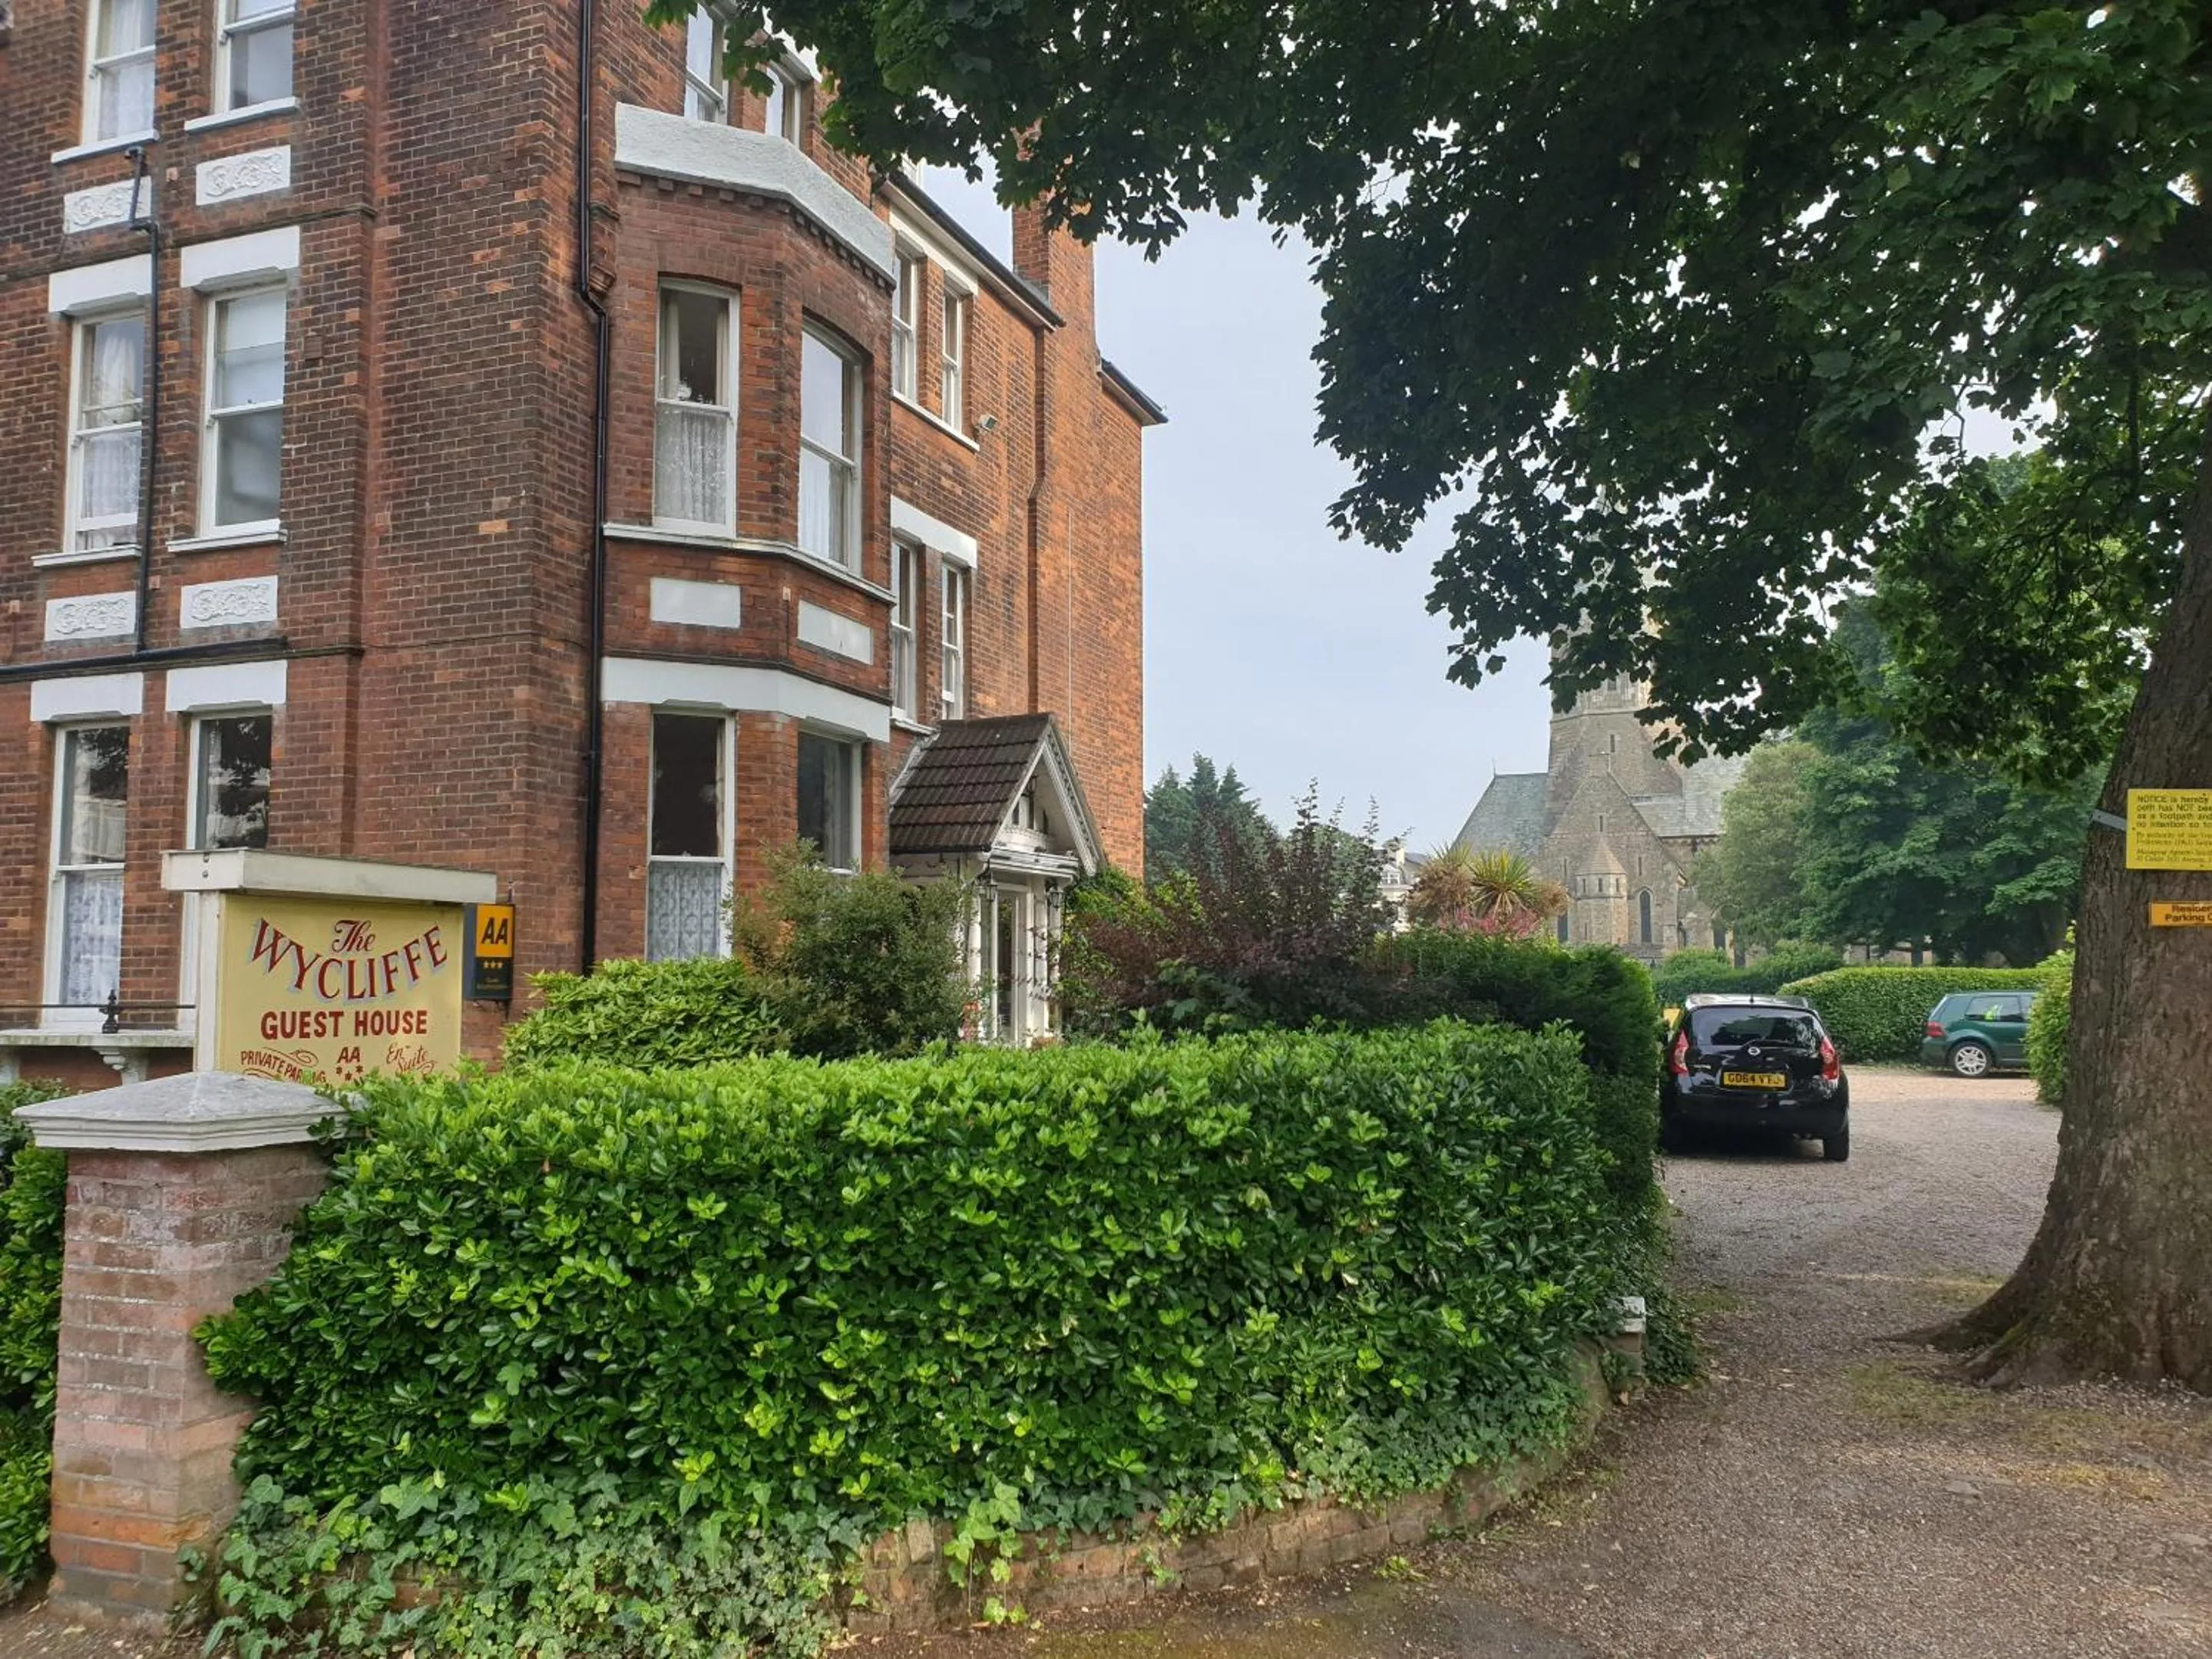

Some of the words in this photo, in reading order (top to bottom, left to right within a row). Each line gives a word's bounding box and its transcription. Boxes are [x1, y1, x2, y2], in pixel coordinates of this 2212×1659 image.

[2137, 795, 2167, 803] NOTICE
[2181, 795, 2209, 805] hereby
[2159, 812, 2194, 821] footpath
[2165, 913, 2205, 922] Parking
[332, 920, 376, 953] The
[481, 917, 508, 945] AA
[252, 918, 448, 999] WYCLIFFE
[261, 1010, 344, 1039] GUEST
[354, 1010, 428, 1036] HOUSE
[240, 1050, 285, 1073] PRIVATE
[336, 1046, 361, 1063] AA
